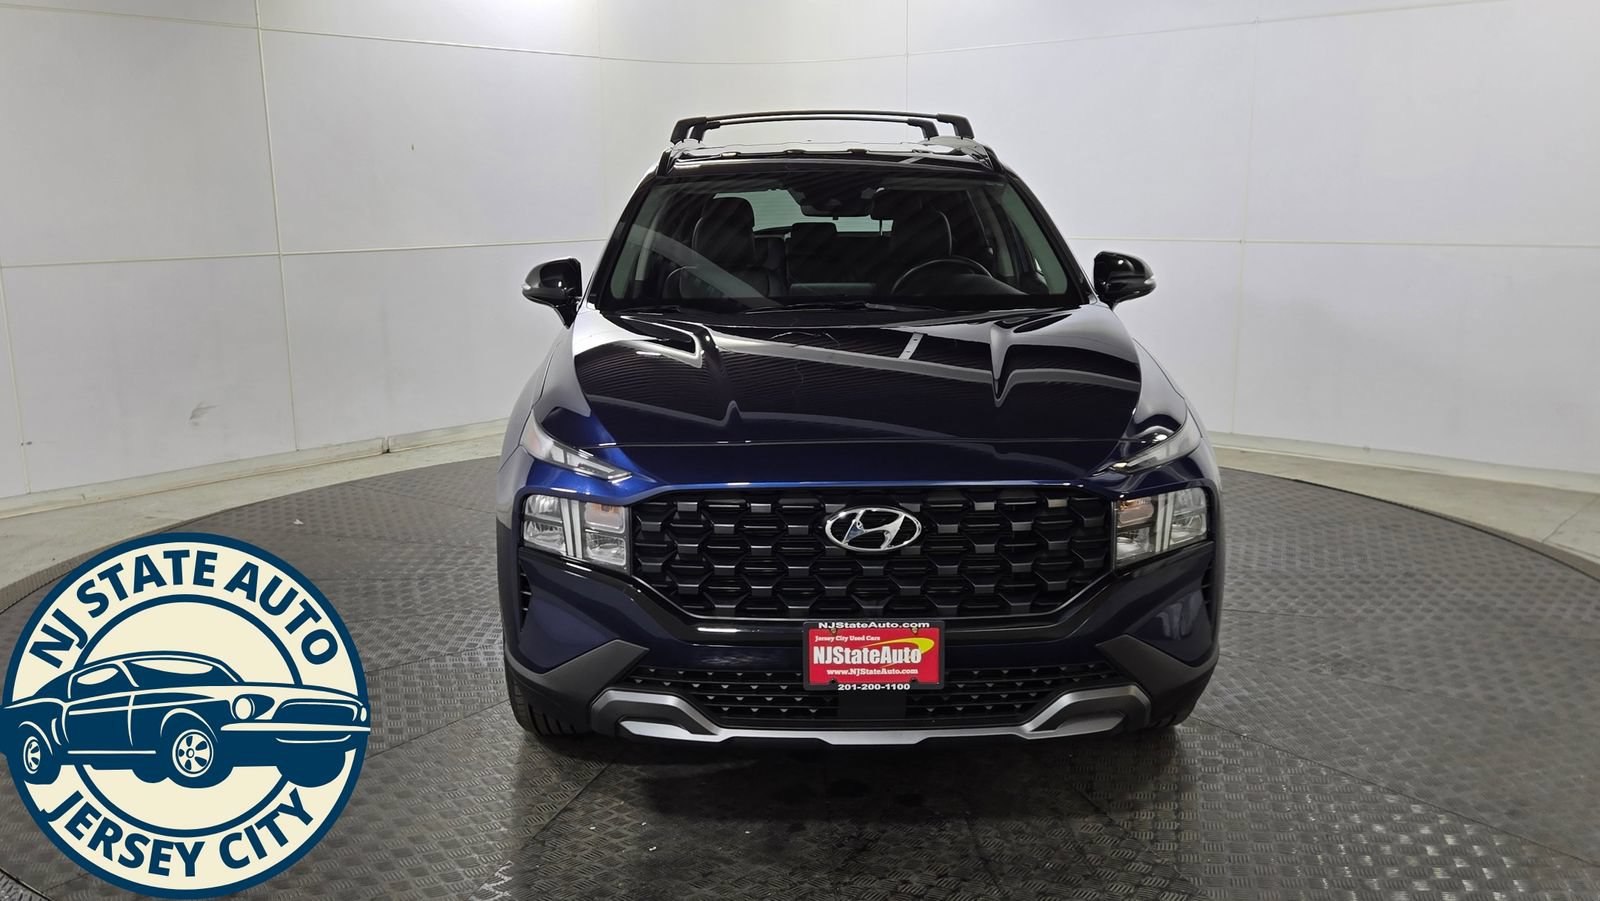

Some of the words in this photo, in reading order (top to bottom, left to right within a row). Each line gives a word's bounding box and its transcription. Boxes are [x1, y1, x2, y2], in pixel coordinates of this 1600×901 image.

[818, 621, 930, 629] NJStateAuto.com
[813, 646, 922, 665] NJStateAuto
[826, 668, 919, 676] www.NJStateAuto.com
[837, 683, 911, 691] 201-200-1100
